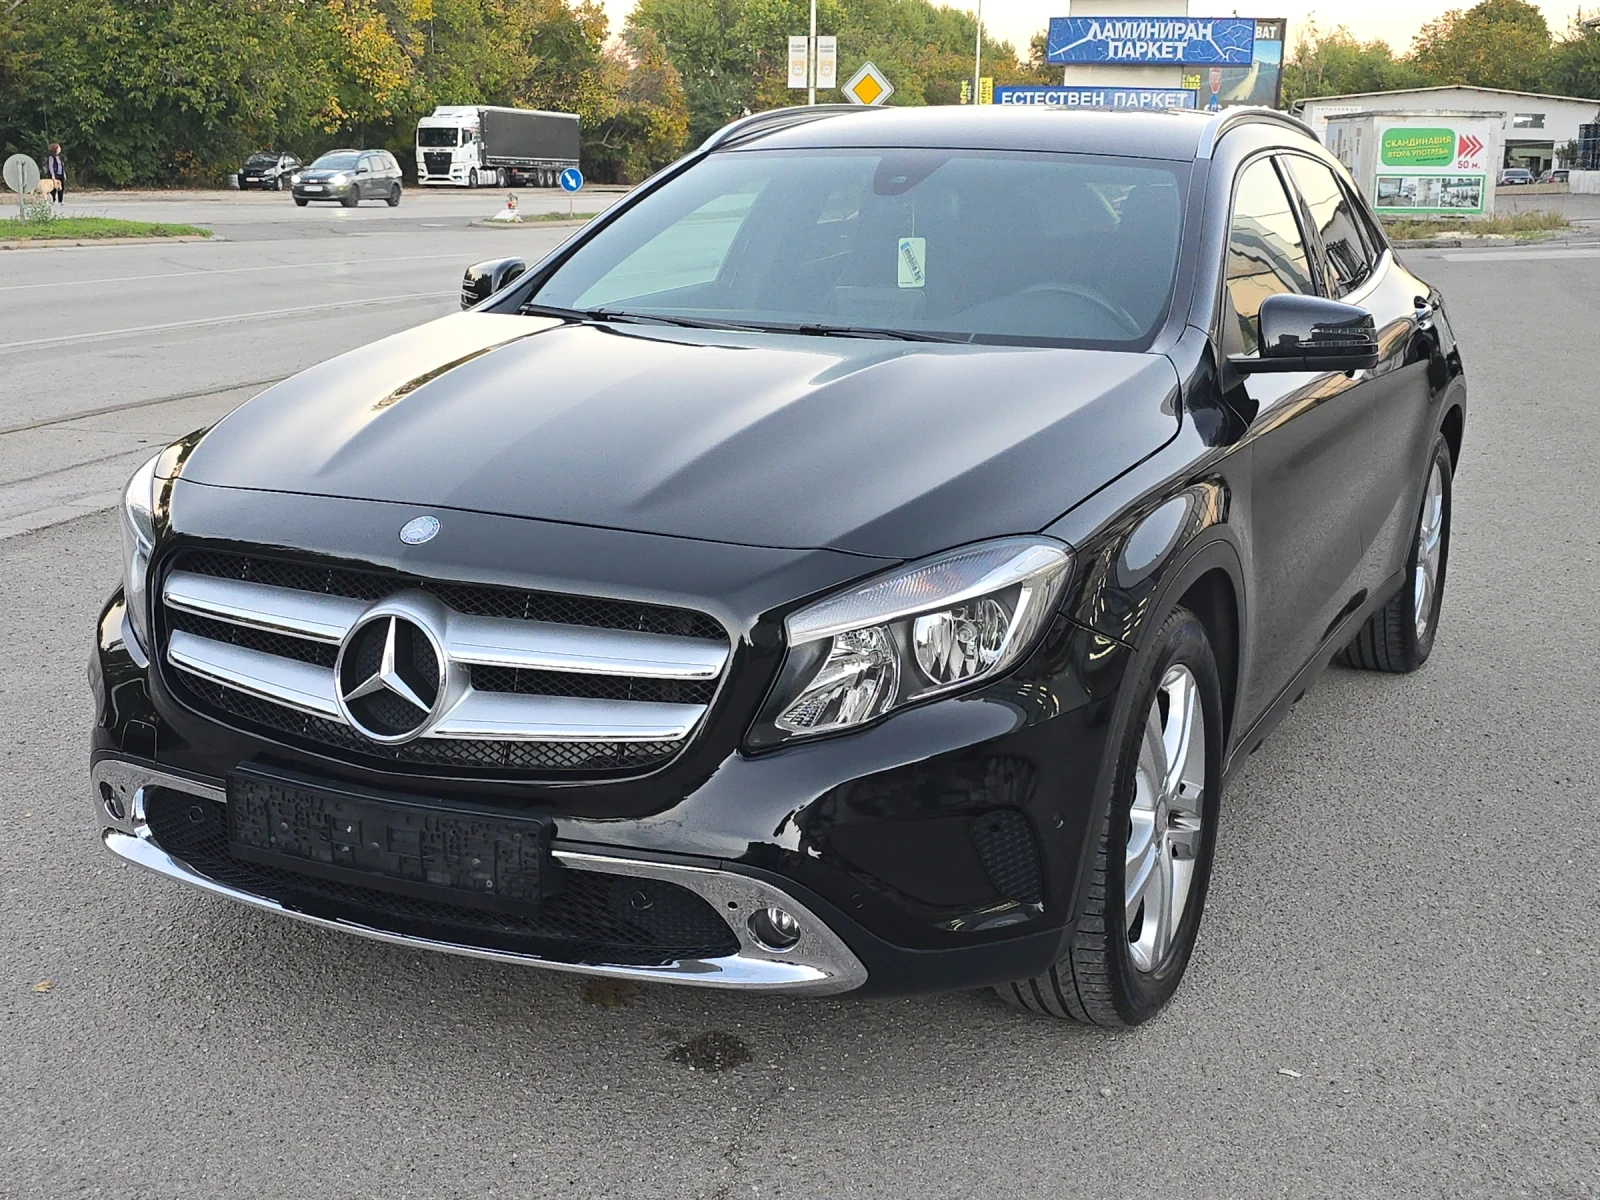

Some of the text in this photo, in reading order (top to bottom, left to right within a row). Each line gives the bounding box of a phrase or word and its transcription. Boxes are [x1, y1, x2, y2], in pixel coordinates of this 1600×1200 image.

[1087, 21, 1213, 41] ЛАМИНИРАН
[1107, 41, 1187, 60] ПАРКЕТ
[1001, 92, 1189, 108] ЕСТЕСТВЕН ПАРКЕТ
[1385, 136, 1452, 148] СКАНДИНАВИЯ
[1387, 150, 1411, 159] ВТОРА
[1412, 148, 1449, 157] УПОТРЕБА
[1457, 160, 1469, 169] 50
[903, 248, 922, 281] mobile.bg
